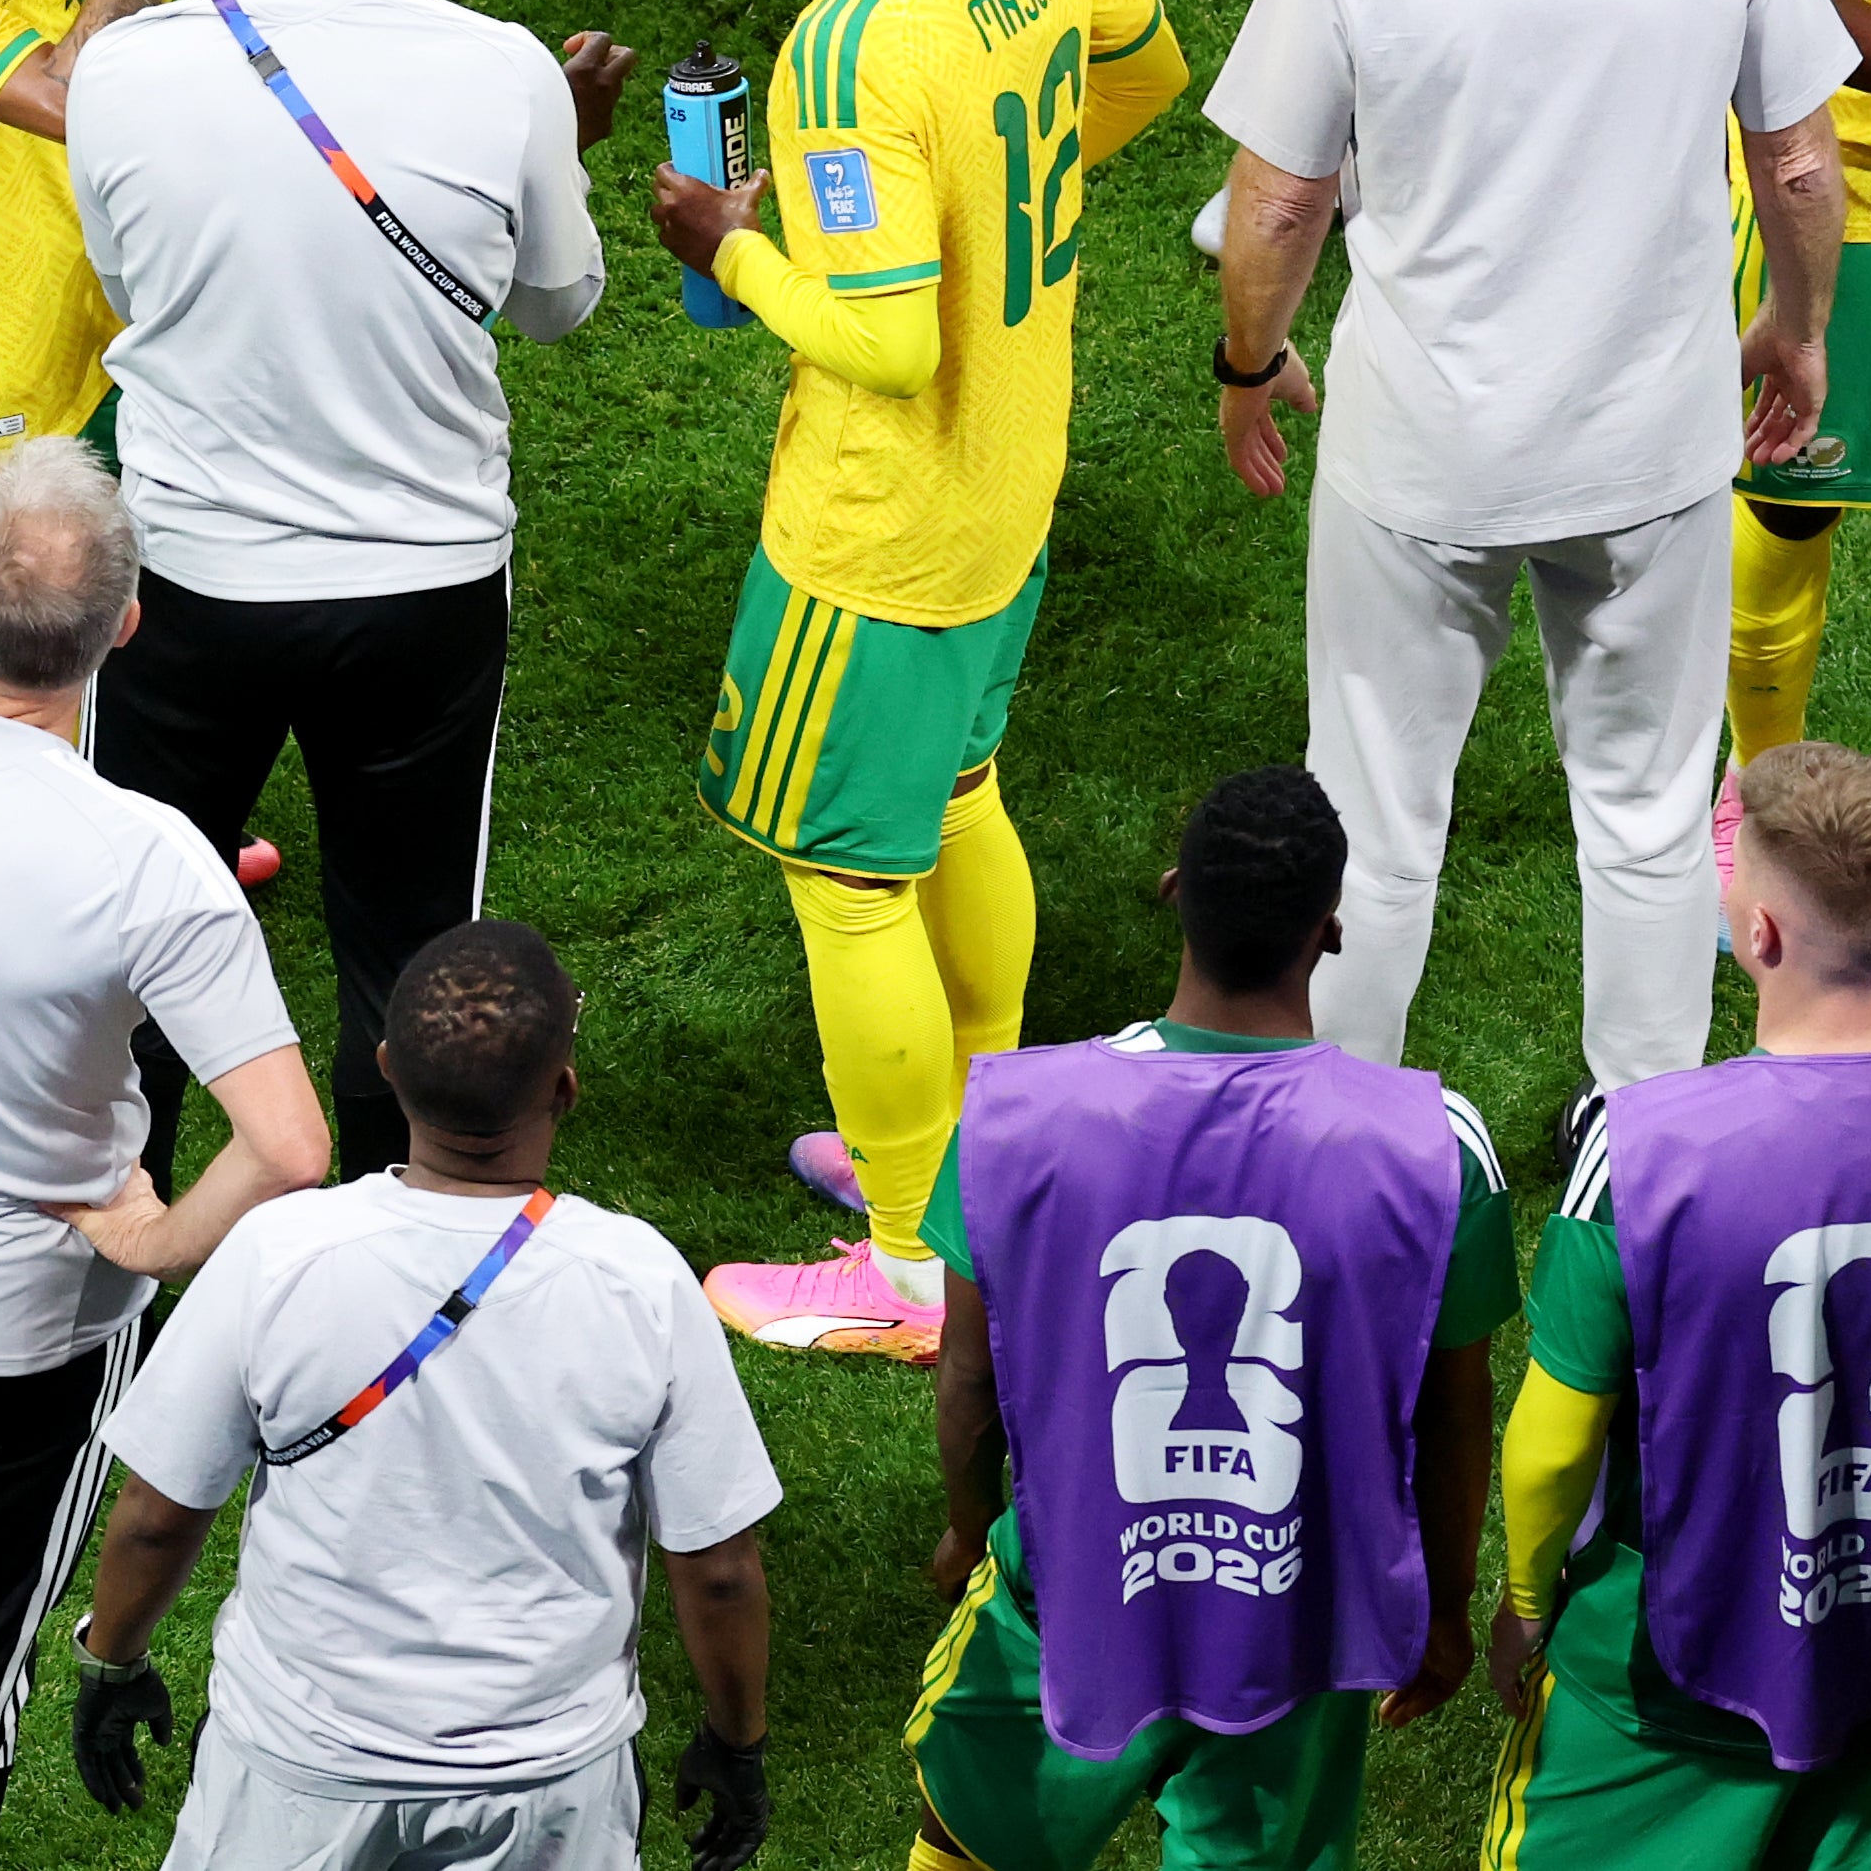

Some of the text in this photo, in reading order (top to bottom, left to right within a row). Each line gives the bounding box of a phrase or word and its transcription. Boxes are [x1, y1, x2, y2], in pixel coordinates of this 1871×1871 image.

[669, 107, 687, 123] 25
[992, 27, 1082, 328] 12
[829, 199, 857, 215] PEACE
[375, 211, 484, 317] FIFA WORLD CUP 2026
[1164, 1444, 1257, 1483] FIFA
[1119, 1510, 1304, 1557] WORLD CUP
[1121, 1541, 1305, 1607] 2026
